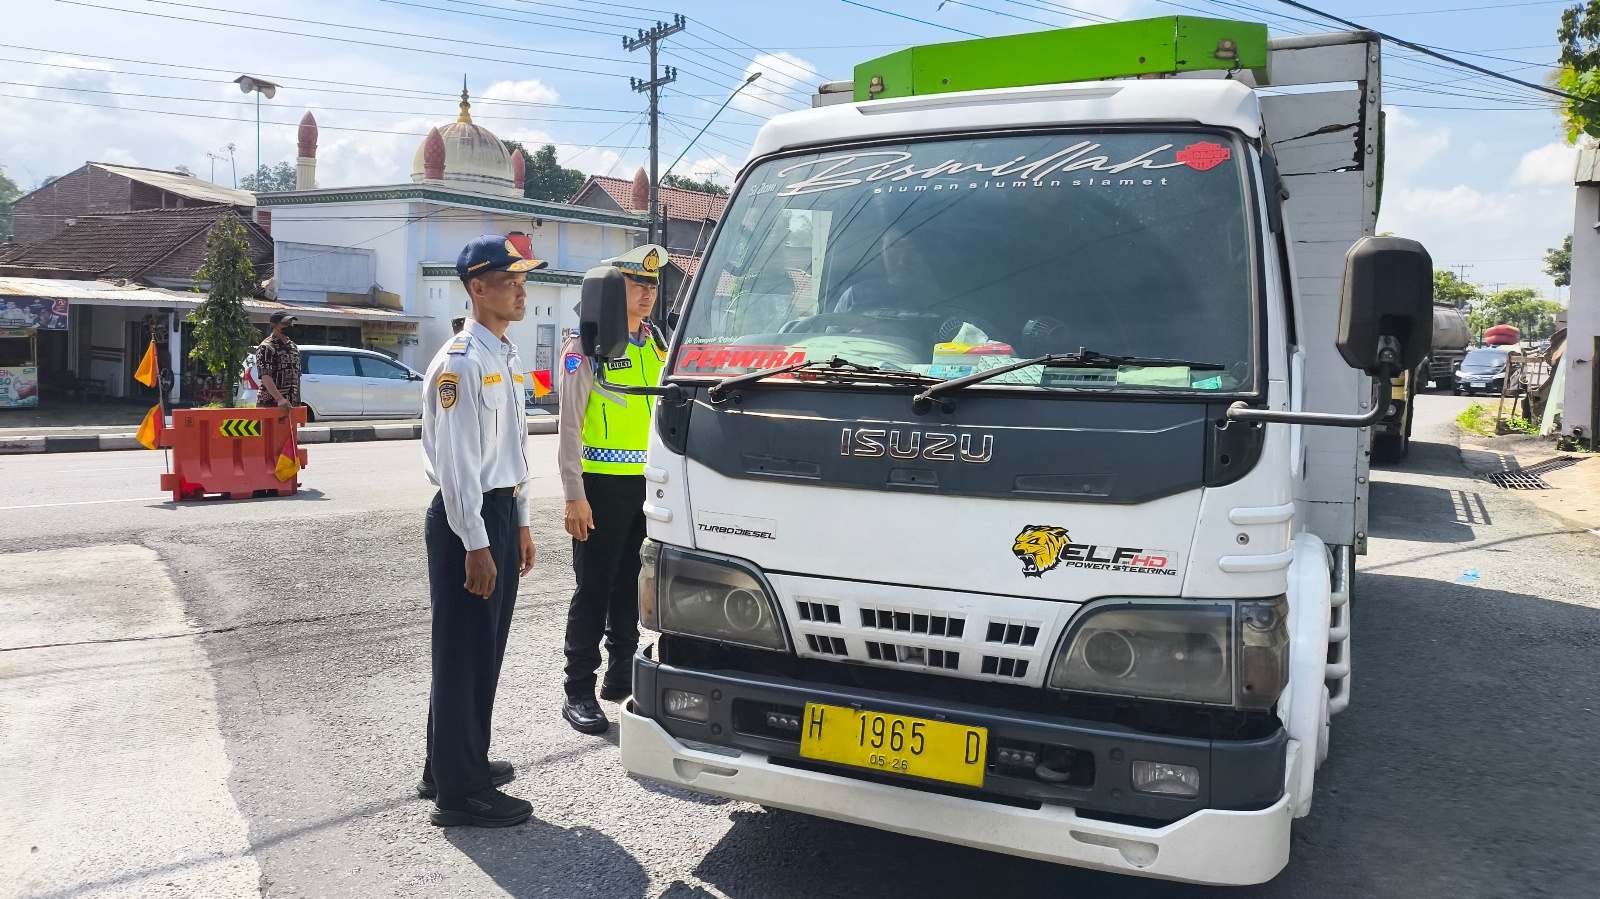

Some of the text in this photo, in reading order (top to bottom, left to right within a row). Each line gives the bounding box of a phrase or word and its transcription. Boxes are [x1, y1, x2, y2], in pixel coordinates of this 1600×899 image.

[777, 140, 1186, 197] Bismillah
[1072, 177, 1169, 187] slamet
[840, 428, 994, 463] ISUZU
[1059, 544, 1169, 567] ELF HD
[1065, 561, 1177, 576] POWER STEERING
[809, 706, 981, 765] H 1965 D
